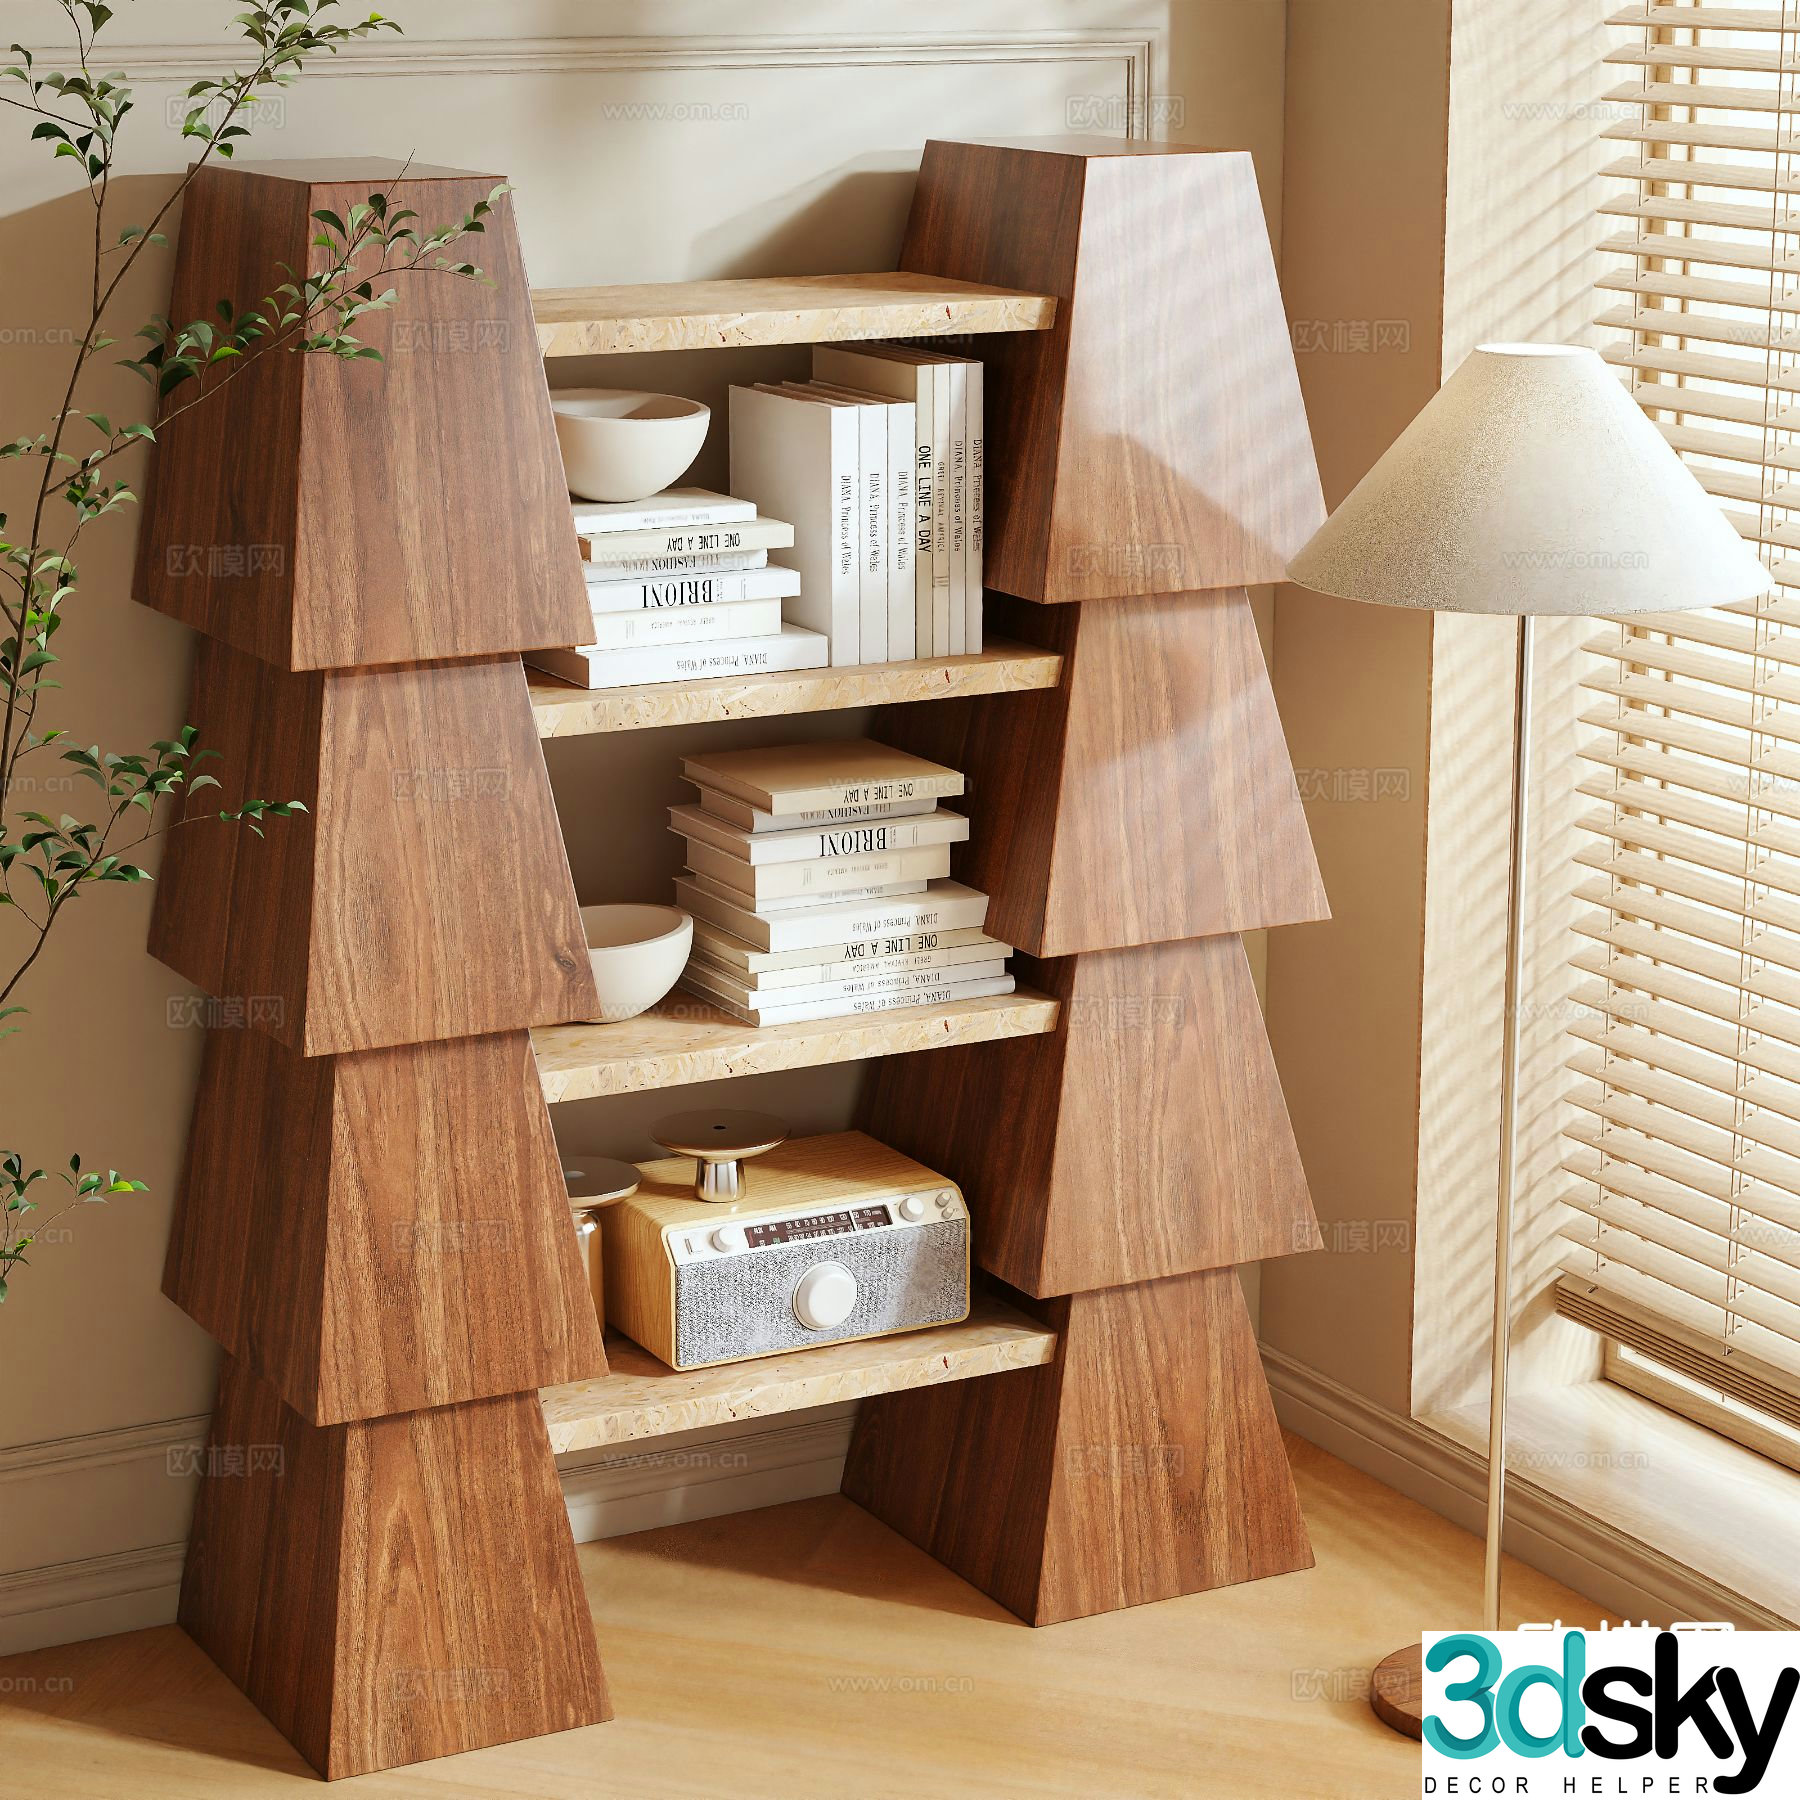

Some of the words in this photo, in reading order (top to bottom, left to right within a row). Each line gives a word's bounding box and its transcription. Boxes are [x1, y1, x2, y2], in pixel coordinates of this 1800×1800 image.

[919, 446, 931, 469] ONE
[919, 478, 931, 507] LINE
[954, 476, 962, 512] Princess
[841, 507, 851, 539] Princess
[869, 504, 880, 537] Princess
[919, 515, 931, 523] A
[954, 516, 962, 524] of
[667, 537, 682, 552] DAY
[688, 537, 693, 549] A
[700, 534, 719, 549] LINE
[725, 533, 740, 547] ONE
[919, 530, 931, 553] DAY
[954, 527, 962, 552] Wales
[869, 549, 880, 572] Wales
[642, 580, 712, 608] BRIONI
[700, 659, 706, 670] of
[709, 656, 738, 667] Princess
[844, 788, 859, 803] DAY
[864, 788, 869, 800] A
[874, 785, 892, 799] LINE
[899, 783, 913, 797] ONE
[820, 827, 887, 856] BRIONI
[852, 922, 872, 934] Wales
[873, 920, 881, 932] of
[883, 917, 910, 930] Princess
[871, 942, 878, 955] A
[885, 937, 910, 954] LINE
[918, 934, 938, 950] ONE
[844, 943, 864, 959] DAY
[843, 983, 865, 992] Wales
[877, 977, 909, 988] Princess
[877, 999, 885, 1009] of
[888, 994, 920, 1006] Princess
